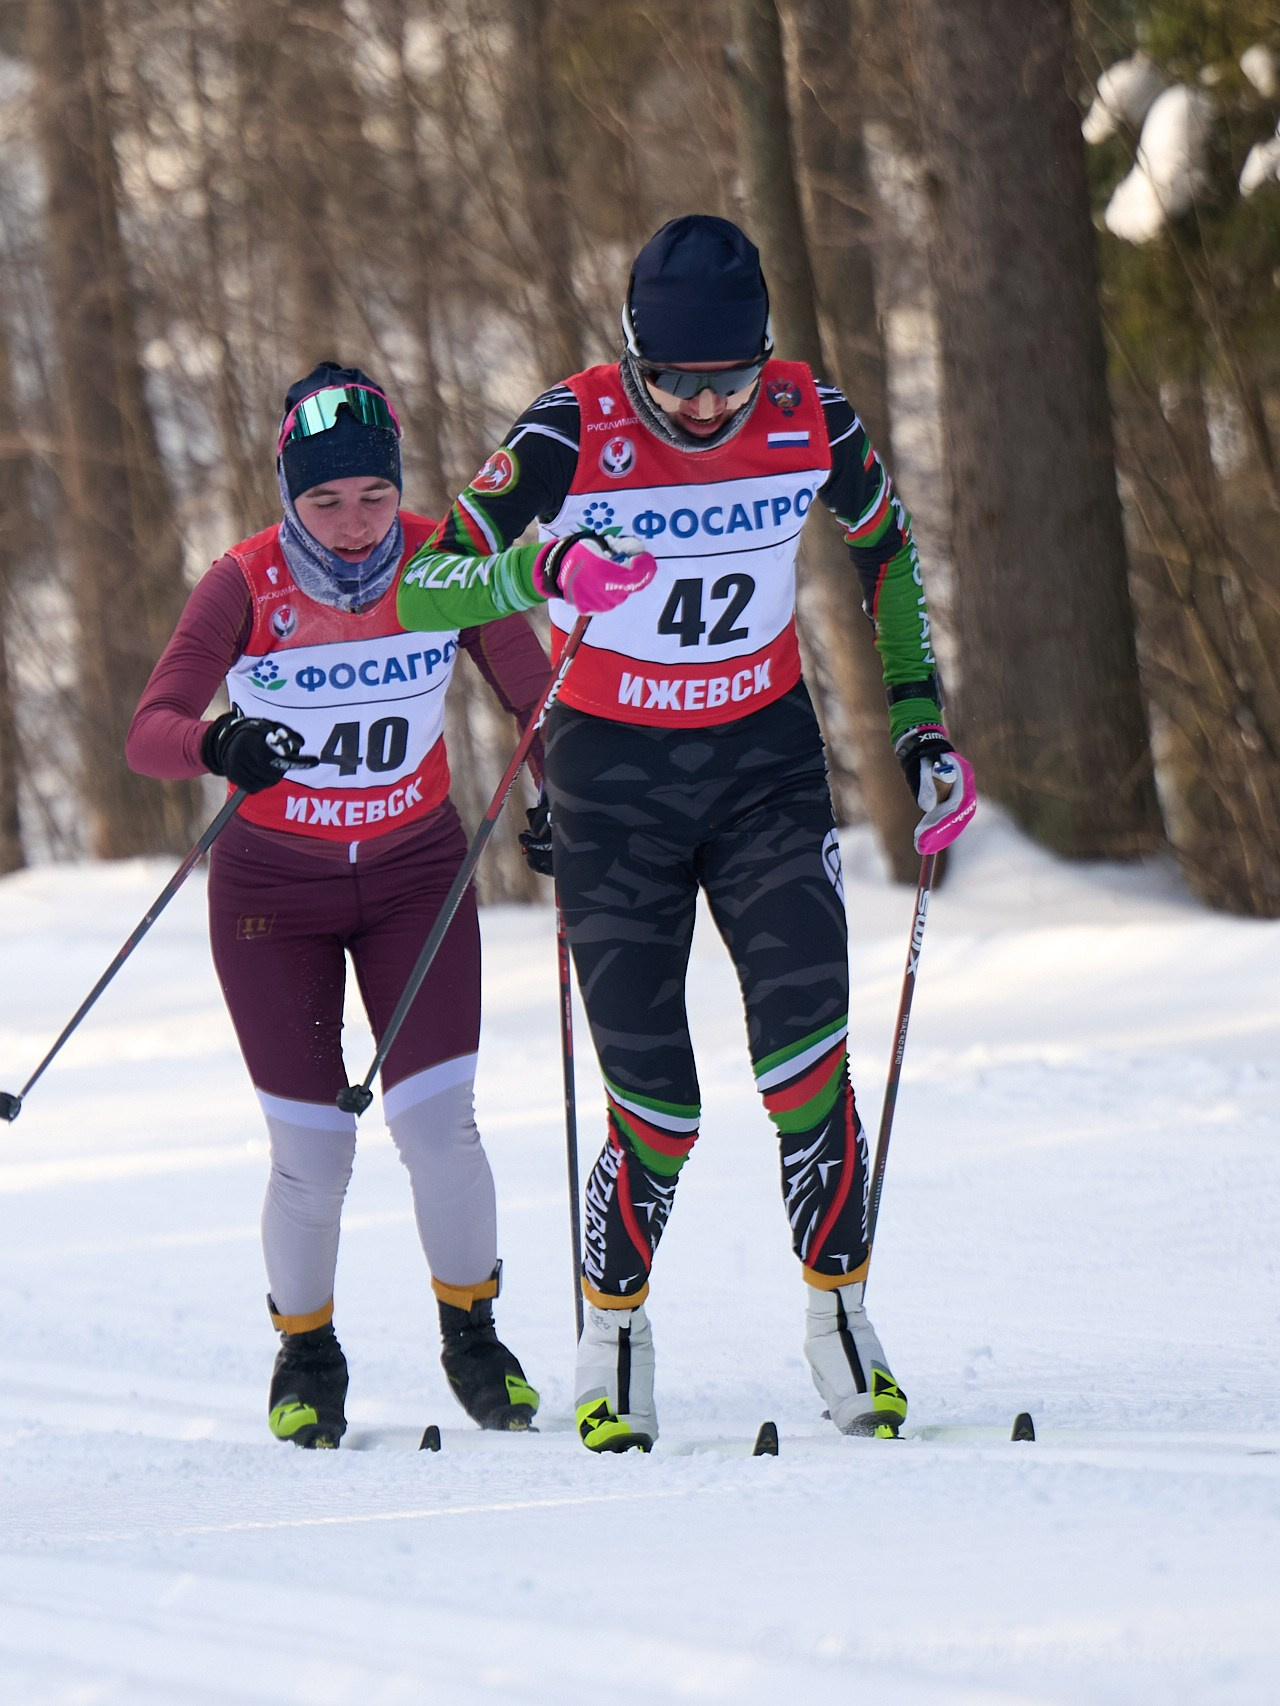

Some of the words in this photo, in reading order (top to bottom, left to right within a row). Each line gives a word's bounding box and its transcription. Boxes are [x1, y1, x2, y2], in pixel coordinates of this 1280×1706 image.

[632, 488, 813, 538] ФОСАГРО
[257, 584, 298, 604] РУСКЛИМА
[658, 573, 756, 648] 42
[618, 658, 772, 712] ИЖЕВСК
[320, 716, 410, 776] 40
[285, 777, 423, 828] ИЖЕВСК
